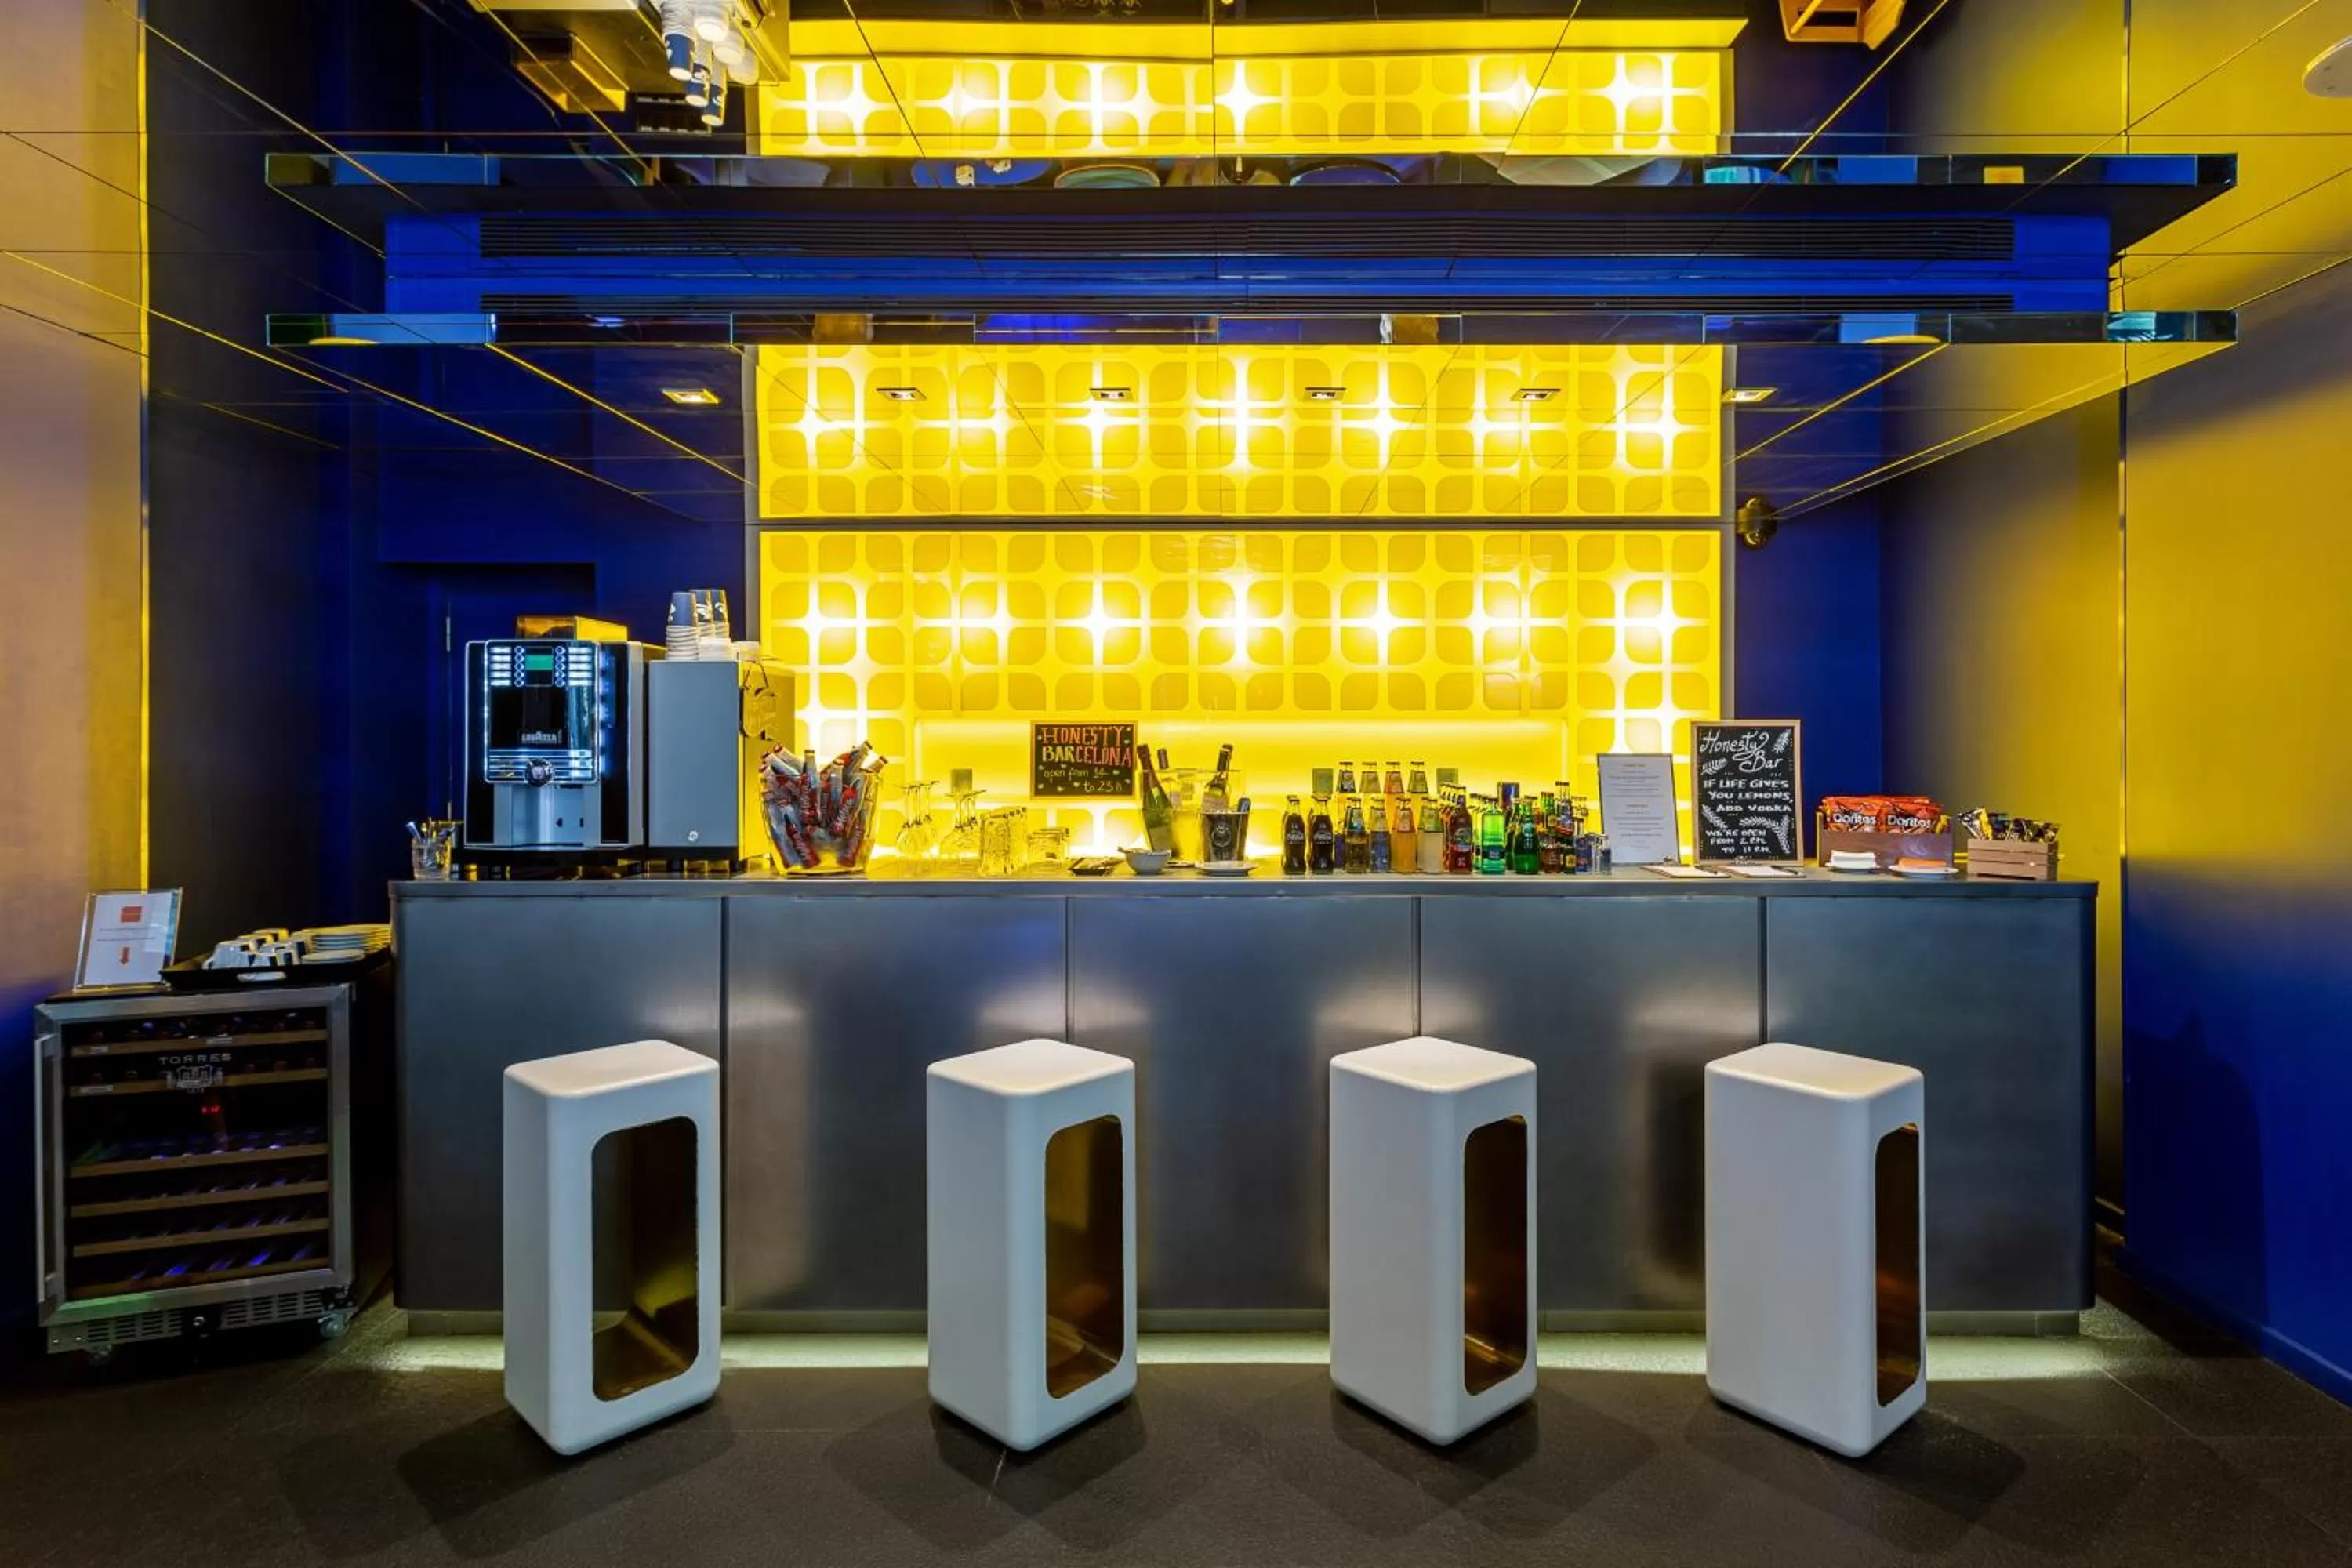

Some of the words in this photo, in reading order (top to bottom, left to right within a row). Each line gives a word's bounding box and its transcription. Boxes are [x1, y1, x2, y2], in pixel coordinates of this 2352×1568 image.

[1041, 726, 1125, 747] HONESTY
[1700, 728, 1769, 760] Honesty
[1042, 746, 1132, 767] BARCELONA
[1739, 750, 1784, 773] Bar
[1044, 769, 1065, 784] open
[1068, 768, 1089, 781] from
[1083, 780, 1094, 793] to
[1703, 779, 1716, 789] IF
[1719, 779, 1747, 789] LIFE
[1749, 778, 1789, 788] GIVES
[1708, 791, 1733, 800] YOU
[1737, 791, 1794, 804] LEMONS,
[1716, 804, 1744, 812] ADD
[1748, 804, 1792, 812] VODKA
[1833, 812, 1876, 825] Doritos
[1887, 815, 1932, 828] Doritos
[158, 1053, 232, 1065] TORRES
